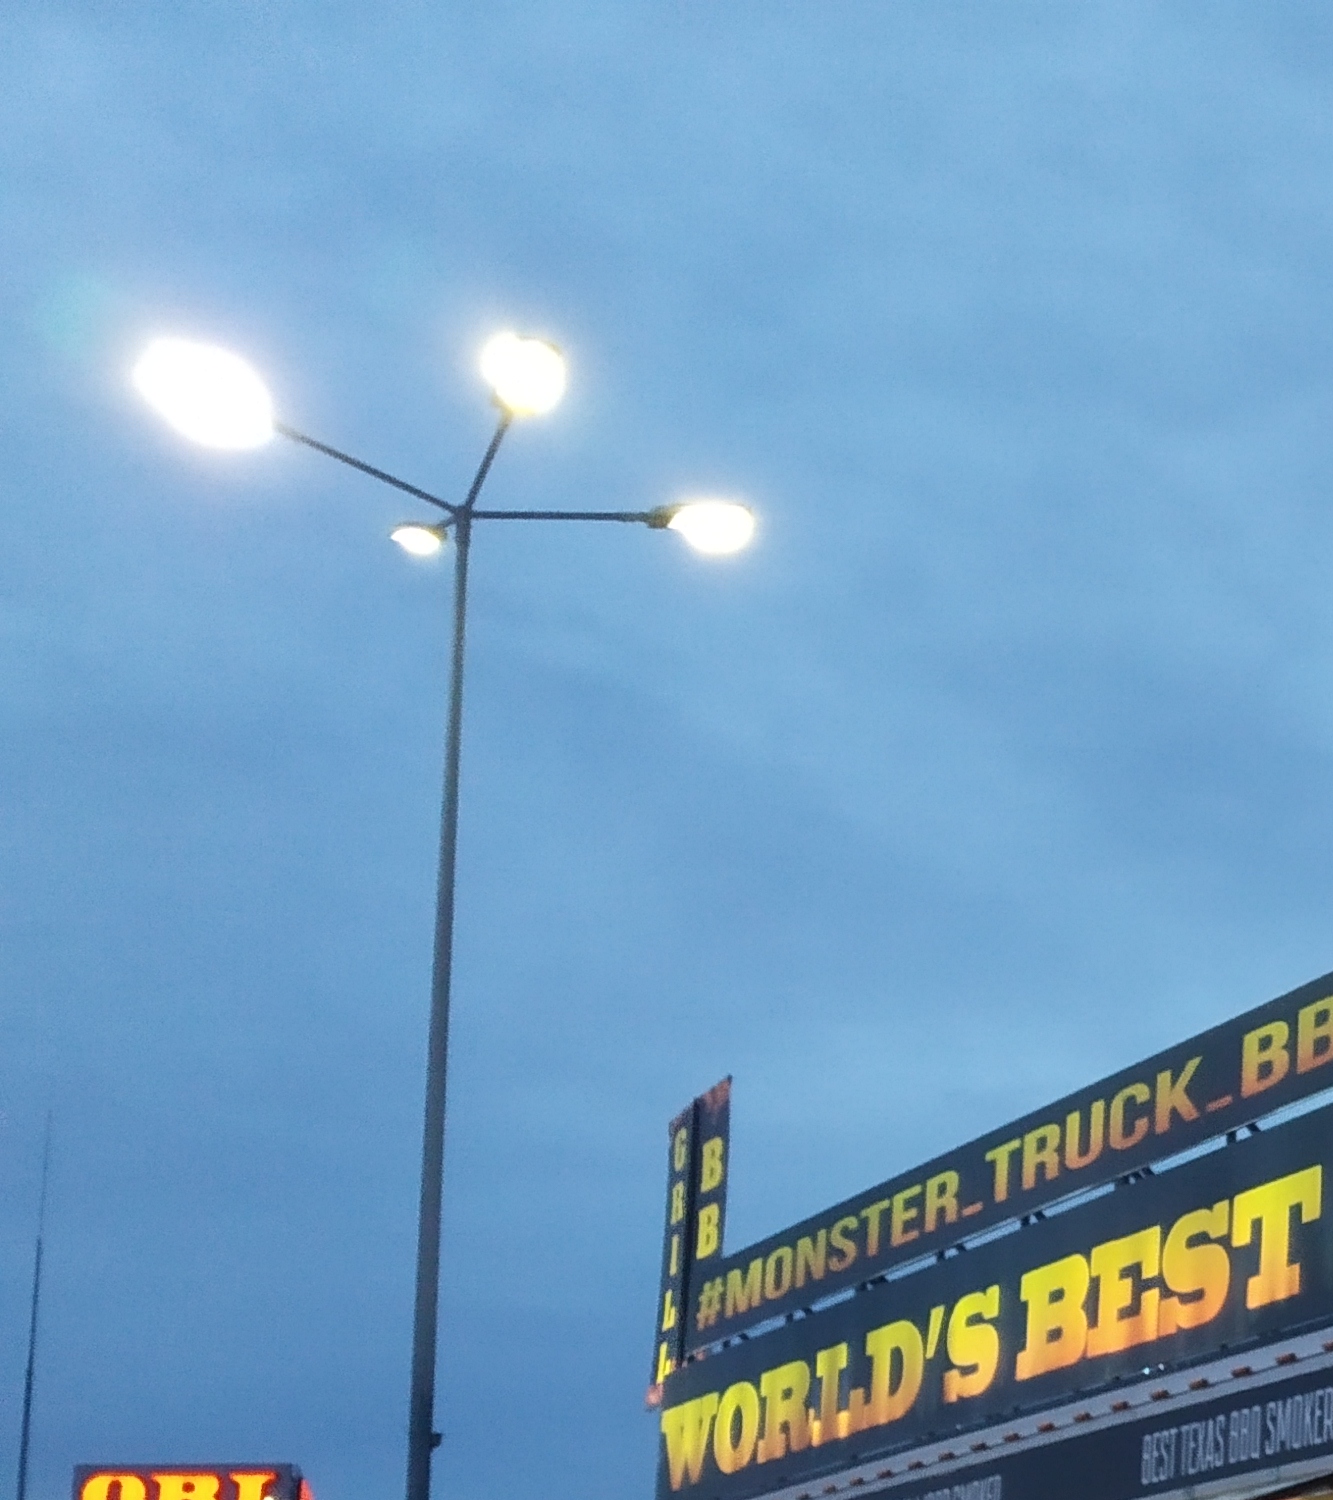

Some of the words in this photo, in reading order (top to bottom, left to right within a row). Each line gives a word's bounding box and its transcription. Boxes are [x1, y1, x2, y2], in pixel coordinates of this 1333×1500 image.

[656, 1126, 688, 1384] GRILL
[696, 1136, 724, 1260] BB
[661, 1284, 998, 1491] WORLD'S
[1015, 1164, 1323, 1381] BEST
[1140, 1428, 1178, 1485] BEST
[1181, 1414, 1226, 1476] TEXAS
[1228, 1405, 1262, 1464] BBQ
